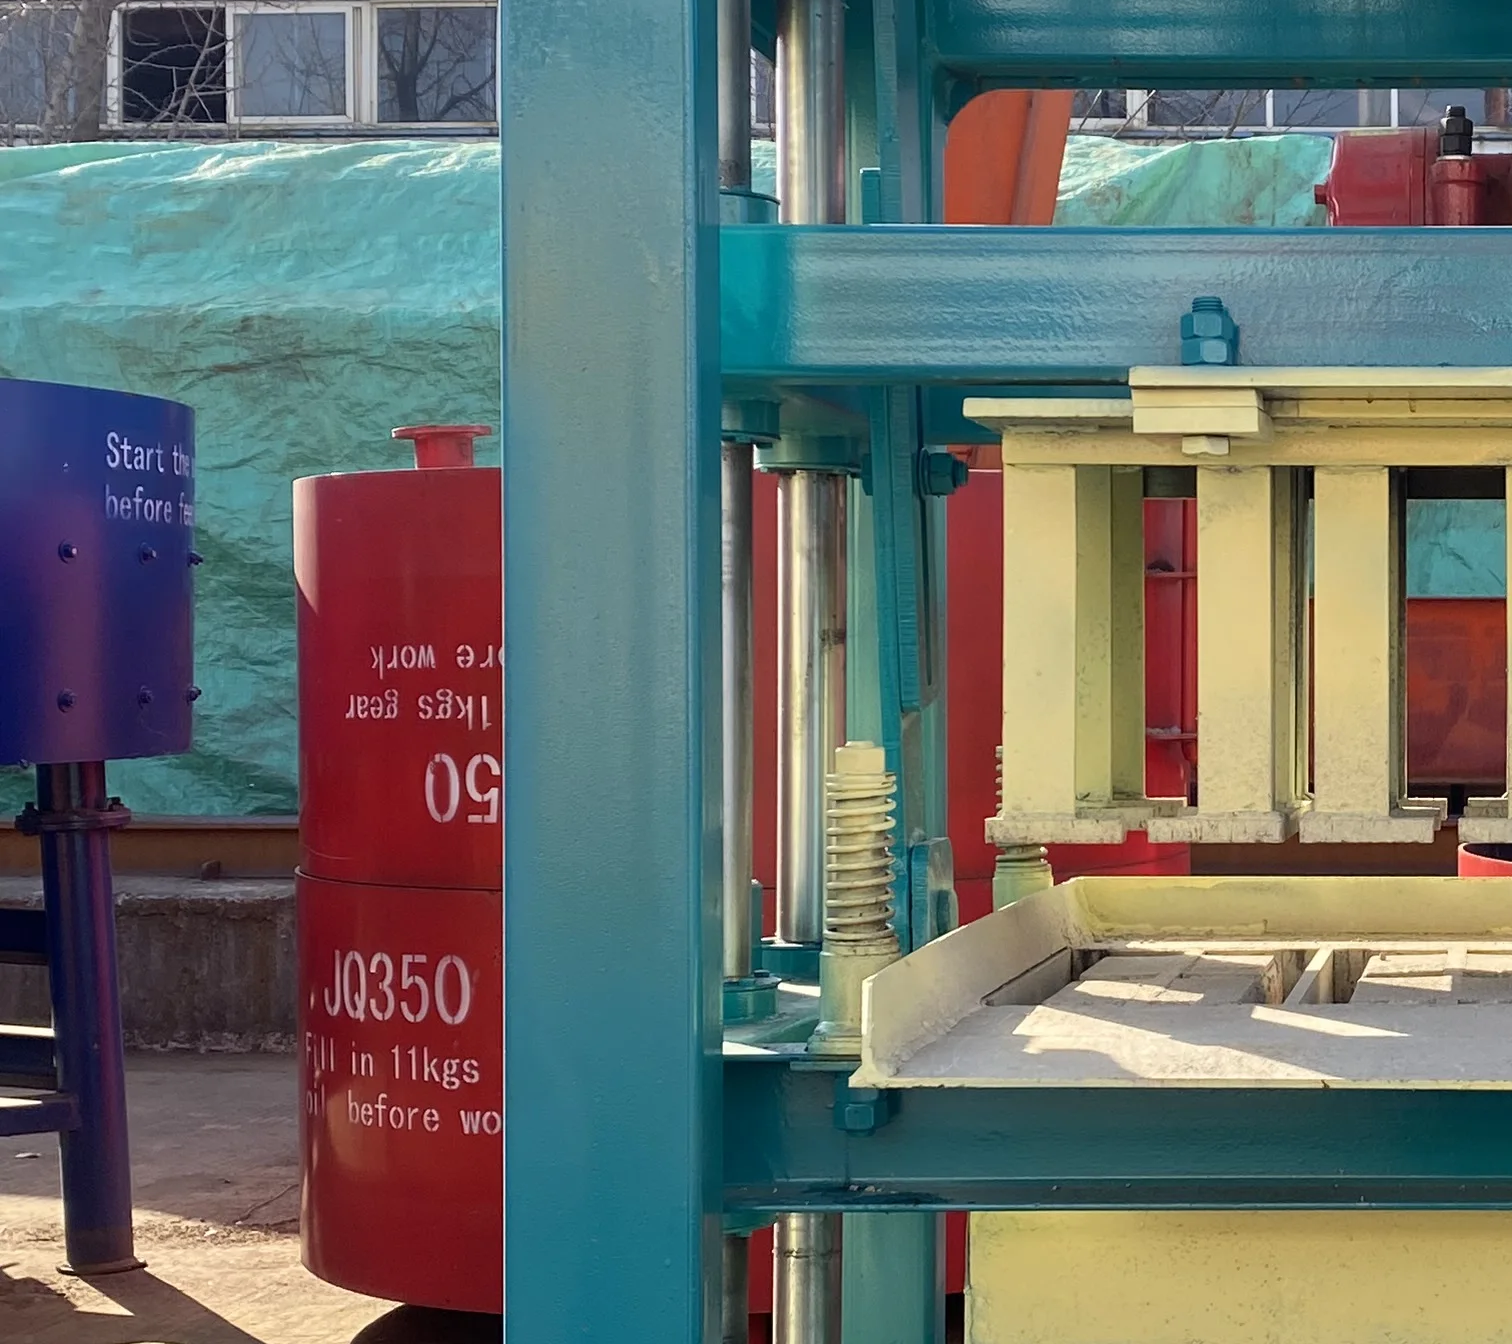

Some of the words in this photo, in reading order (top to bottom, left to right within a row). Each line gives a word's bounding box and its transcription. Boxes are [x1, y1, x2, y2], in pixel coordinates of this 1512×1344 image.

[106, 431, 165, 473] Start
[104, 483, 173, 524] before
[370, 644, 437, 680] work
[345, 688, 399, 719] gear
[324, 950, 471, 1025] JQ350
[351, 1040, 375, 1077] in
[391, 1044, 481, 1090] 11kgs
[347, 1089, 441, 1132] before
